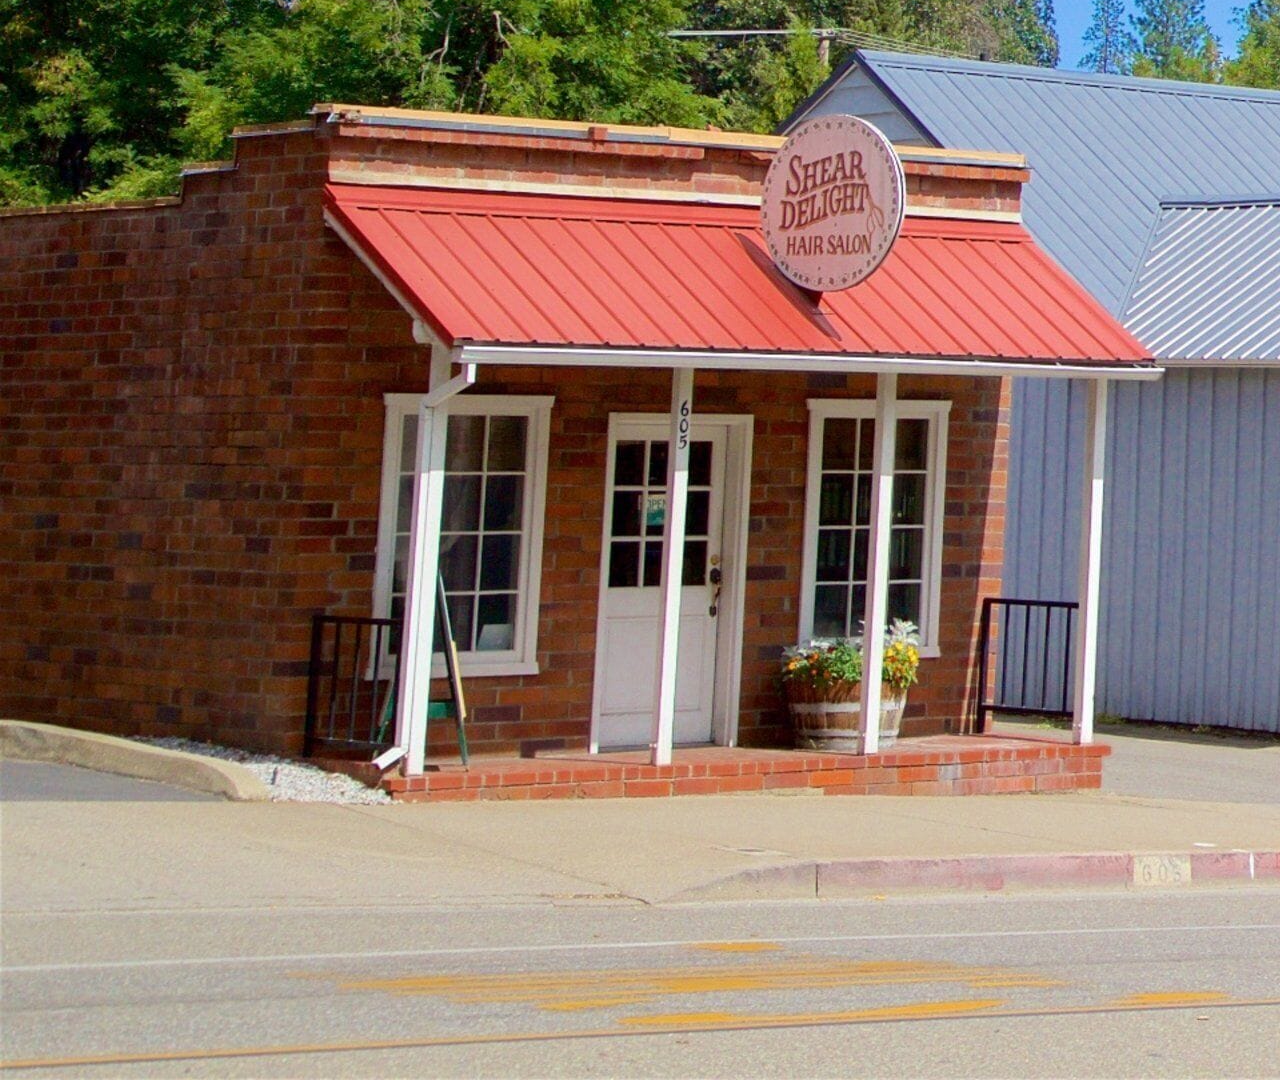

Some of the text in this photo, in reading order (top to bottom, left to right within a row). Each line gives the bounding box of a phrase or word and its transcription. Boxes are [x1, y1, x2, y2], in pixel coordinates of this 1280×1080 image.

[785, 150, 867, 197] SHEAR
[779, 183, 870, 230] DELIGHT
[786, 234, 872, 257] HAIR SALON
[678, 400, 689, 450] 605
